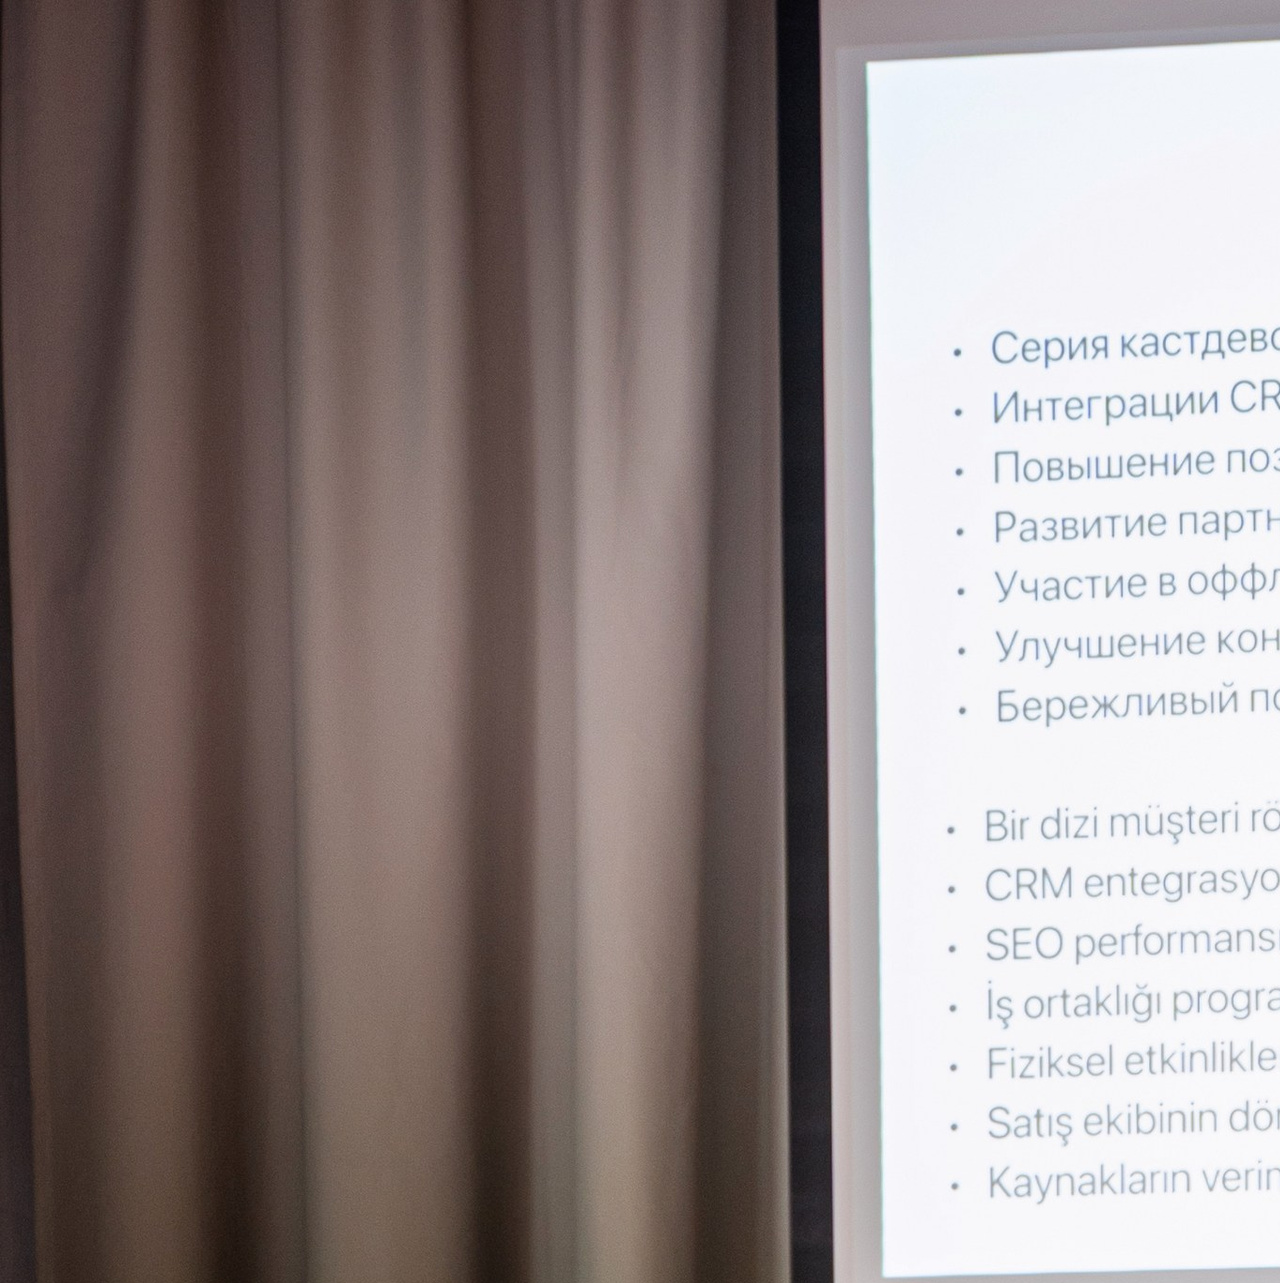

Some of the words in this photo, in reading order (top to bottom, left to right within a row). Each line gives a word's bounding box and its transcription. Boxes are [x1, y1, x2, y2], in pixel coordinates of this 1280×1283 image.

[992, 330, 1109, 370] Серия
[993, 390, 1219, 427] Интеграции
[994, 450, 1215, 484] Повышение
[995, 510, 1167, 543] Развитие
[994, 570, 1147, 603] Участие
[1159, 572, 1177, 597] в
[995, 630, 1206, 668] Улучшение
[998, 682, 1238, 728] Бережливый
[986, 809, 1030, 842] Bir
[1040, 806, 1097, 840] dizi
[1110, 801, 1238, 845] müşteri
[985, 866, 1072, 902] CRM
[987, 926, 1063, 961] SEO
[988, 980, 1014, 1029] İş
[1024, 984, 1161, 1023] ortaklığı
[988, 1044, 1113, 1079] Fiziksel
[988, 1106, 1073, 1147] Satış
[1084, 1102, 1217, 1136] ekibinin
[990, 1163, 1190, 1205] Kaynakların
